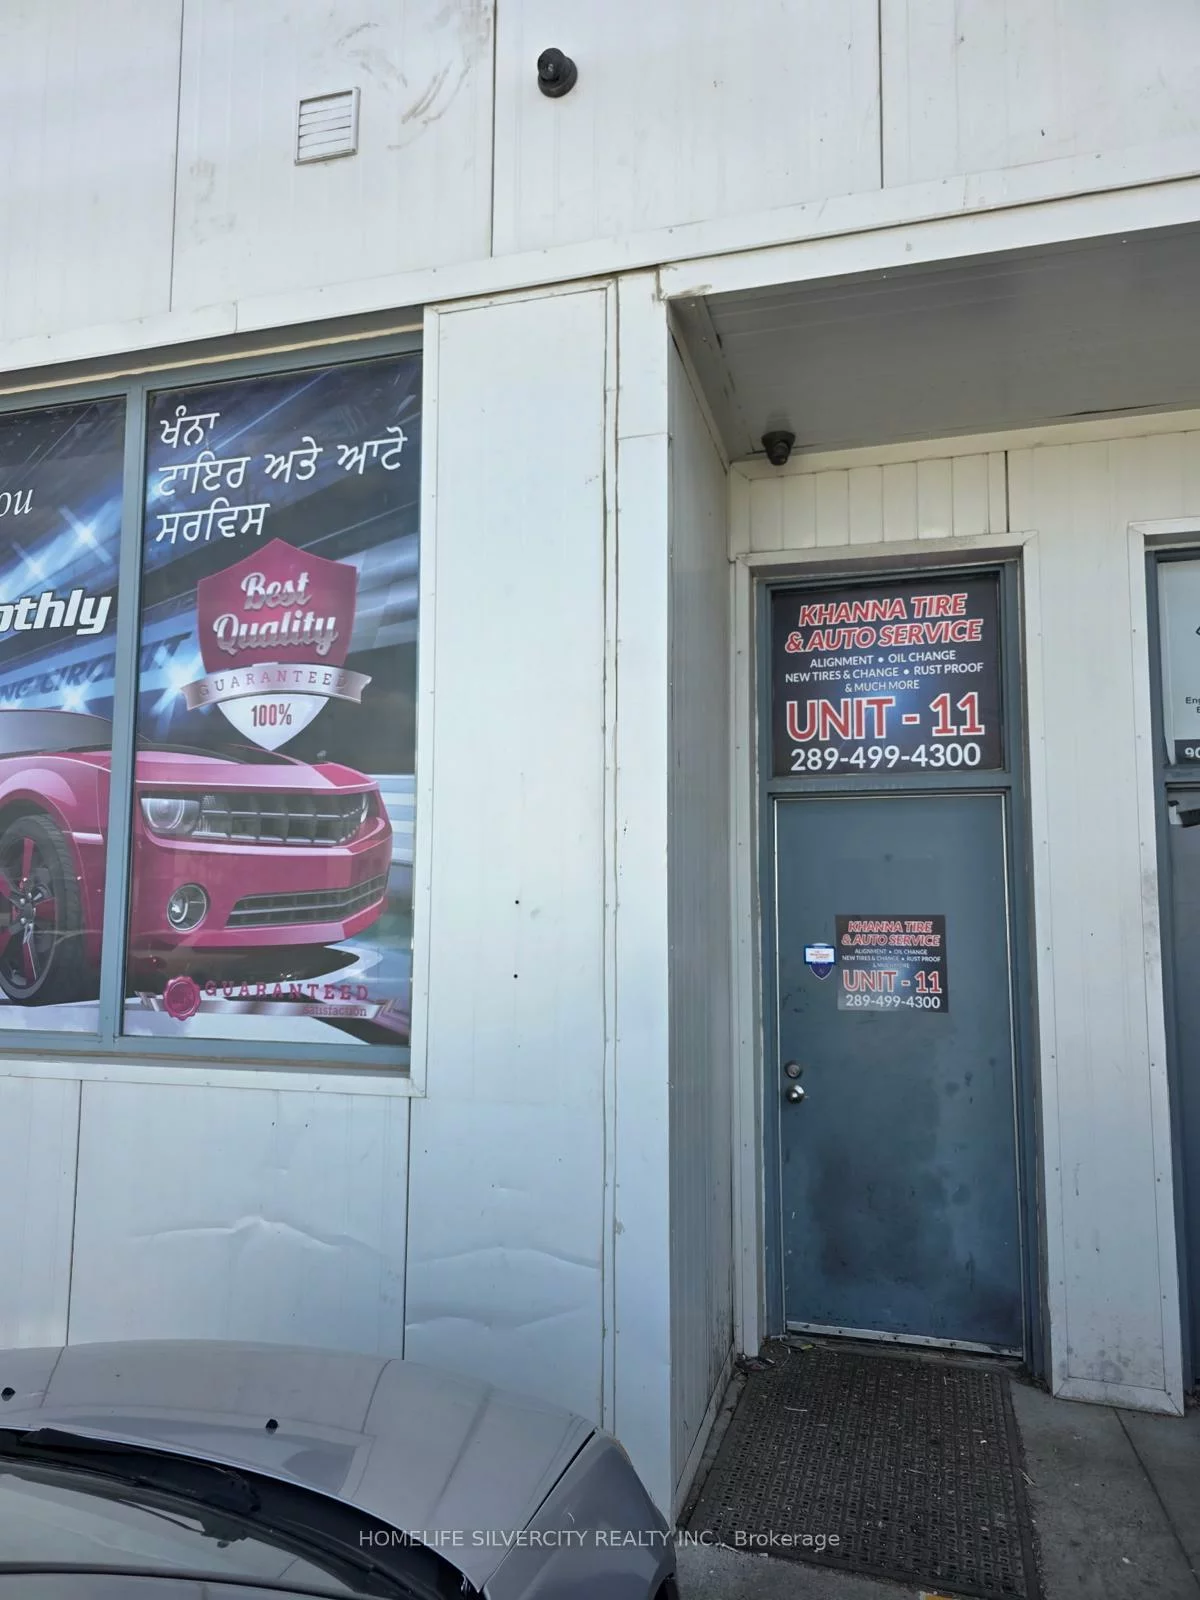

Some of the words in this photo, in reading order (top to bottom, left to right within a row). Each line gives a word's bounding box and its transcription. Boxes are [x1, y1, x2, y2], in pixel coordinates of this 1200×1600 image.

[160, 405, 220, 448] ਖੰਨਾ
[158, 450, 251, 496] ਟਾਇਰ
[264, 436, 323, 483] ਅਤੇ
[337, 426, 408, 475] ਆਟੋ
[155, 497, 271, 544] ਸਰਵਿਸ
[241, 572, 312, 610] Best
[798, 598, 907, 627] KHANNA
[911, 593, 968, 618] TIRE
[213, 611, 338, 656] Quality
[785, 632, 804, 653] &
[806, 626, 876, 652] AUTO
[878, 619, 983, 647] SERVICE
[810, 655, 874, 668] ALIGNMENT
[888, 653, 906, 664] OIL
[908, 650, 956, 663] CHANGE
[785, 671, 811, 683] NEW
[812, 671, 841, 682] TIRES
[843, 670, 851, 680] &
[852, 667, 899, 679] CHANGE
[914, 665, 942, 675] RUST
[944, 663, 984, 674] PROOF
[845, 684, 852, 693] &
[854, 682, 887, 692] MUCH
[889, 680, 920, 690] MORE
[251, 703, 292, 727] 100%
[786, 696, 896, 742] UNIT
[929, 692, 985, 737] 11
[790, 743, 981, 771] 289-499-4300
[848, 920, 903, 933] KHANNA
[904, 921, 933, 933] TIRE
[841, 933, 851, 946] &
[852, 934, 888, 946] AUTO
[888, 934, 941, 947] SERVICE
[205, 980, 369, 1000] GUARANTEED
[843, 969, 898, 993] UNIT
[914, 971, 942, 994] 11
[845, 994, 941, 1009] 289-499-4300
